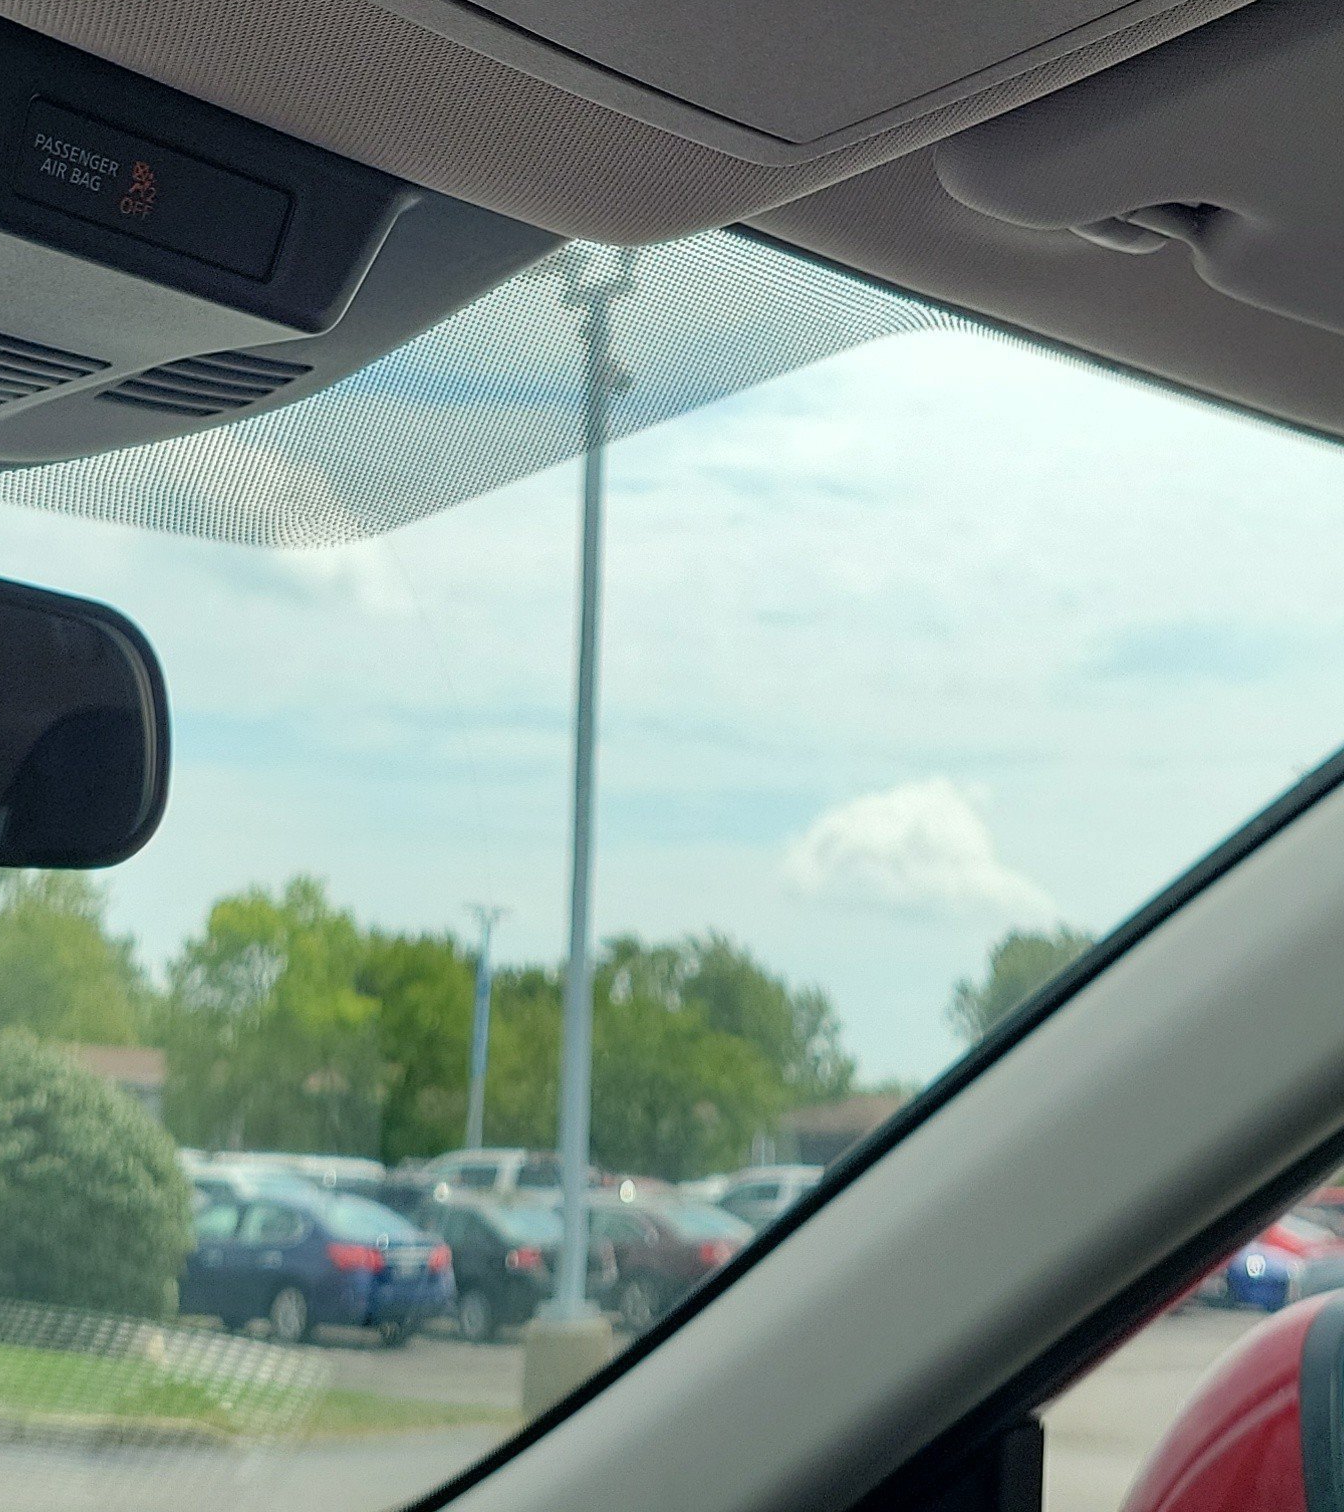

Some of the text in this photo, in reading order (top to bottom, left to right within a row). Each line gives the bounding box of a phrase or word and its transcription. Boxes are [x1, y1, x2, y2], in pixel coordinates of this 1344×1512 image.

[34, 133, 119, 177] PASSENGER
[40, 158, 102, 191] AIR BAG
[119, 196, 155, 219] OFF
